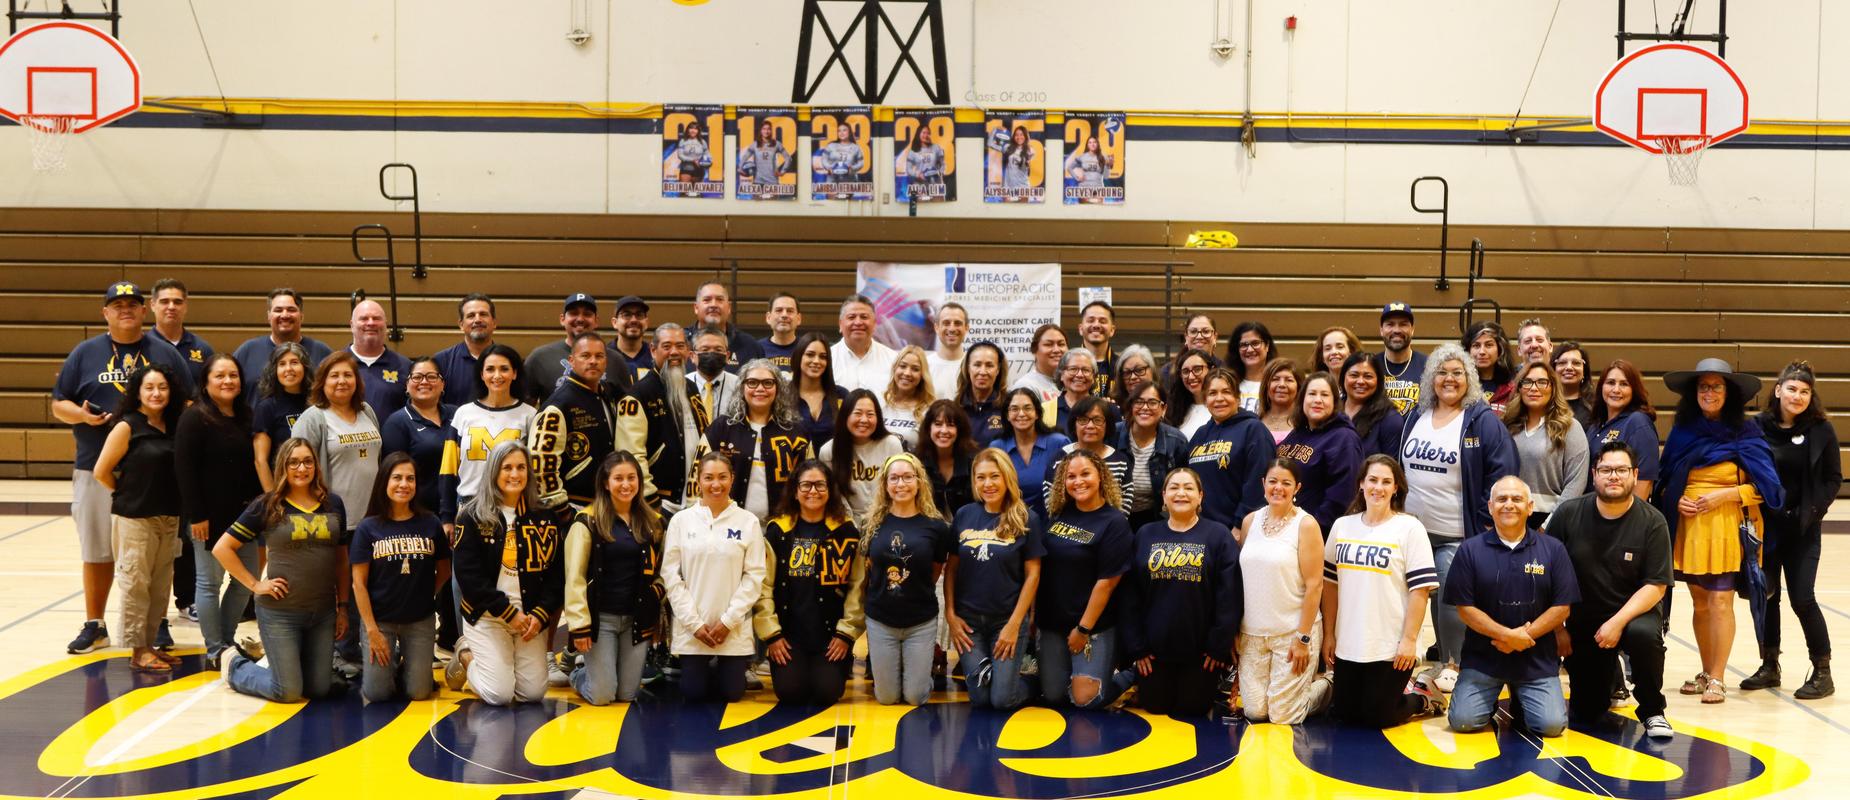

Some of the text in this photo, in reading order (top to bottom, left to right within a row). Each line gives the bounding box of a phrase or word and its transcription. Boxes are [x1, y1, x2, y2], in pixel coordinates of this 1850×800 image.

[1018, 91, 1047, 103] 2010
[663, 182, 724, 193] BELINDA ALVAREZ
[738, 184, 762, 194] ALEXA
[839, 182, 872, 193] HERNANDEZ
[985, 187, 1044, 198] ALYSSA MORENO
[1065, 187, 1123, 199] STEVEY YOUNG
[968, 273, 1020, 283] URTEAGA
[115, 284, 135, 296] M
[967, 282, 1055, 294] CHIROPRACTIC
[576, 293, 586, 301] P
[985, 318, 1029, 326] ACCIDENT
[1030, 317, 1055, 325] CARE
[618, 399, 639, 416] 30
[536, 412, 560, 432] 42
[883, 418, 917, 428] LERS
[466, 426, 521, 461] M
[532, 433, 557, 452] 13
[359, 449, 368, 458] M
[1403, 437, 1458, 465] Oilers
[770, 436, 810, 482] M
[852, 461, 880, 482] iler
[289, 514, 331, 541] M
[727, 528, 742, 540] M
[522, 525, 558, 572] M
[388, 554, 425, 562] OILERS
[820, 538, 860, 586] M
[1147, 546, 1205, 572] Oilers
[1335, 543, 1392, 570] OILERS
